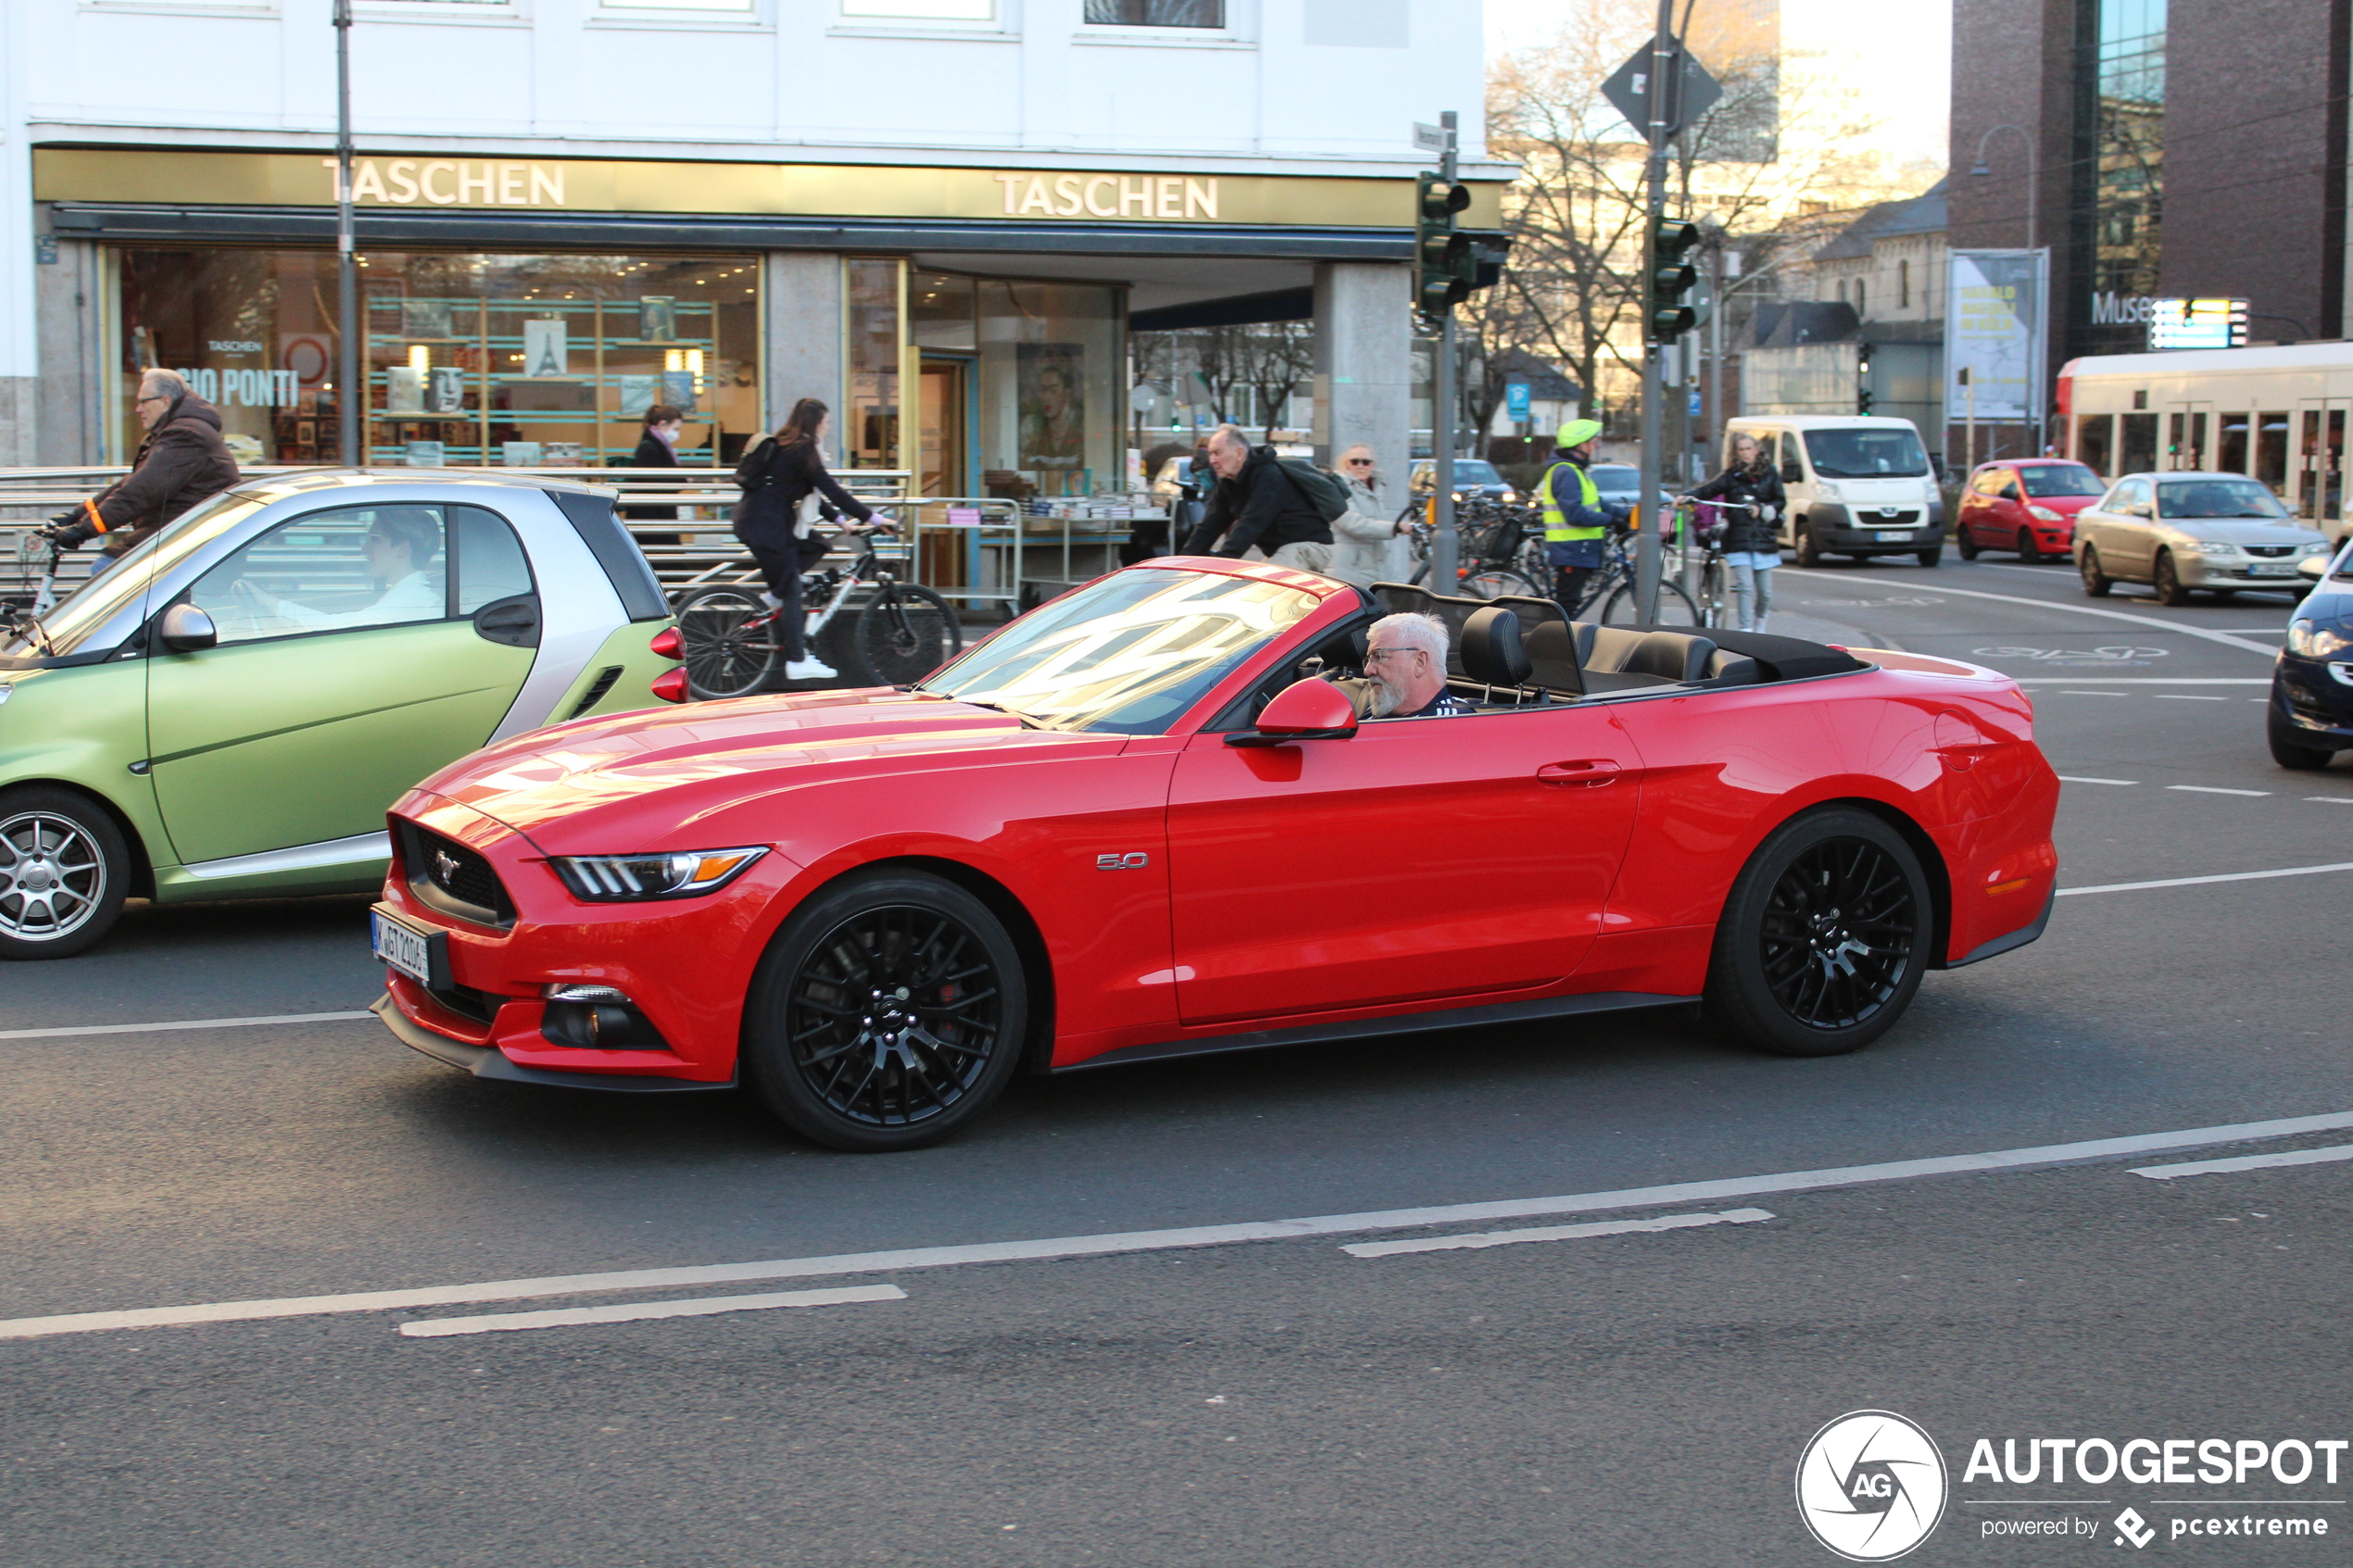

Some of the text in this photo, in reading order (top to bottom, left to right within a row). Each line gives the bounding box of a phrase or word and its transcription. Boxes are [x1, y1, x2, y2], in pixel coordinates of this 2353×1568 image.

[322, 159, 564, 205] TASCHEN
[994, 173, 1218, 219] TASCHEN
[208, 340, 263, 352] TASCHEN
[222, 369, 299, 408] PONTI
[377, 920, 384, 951] K
